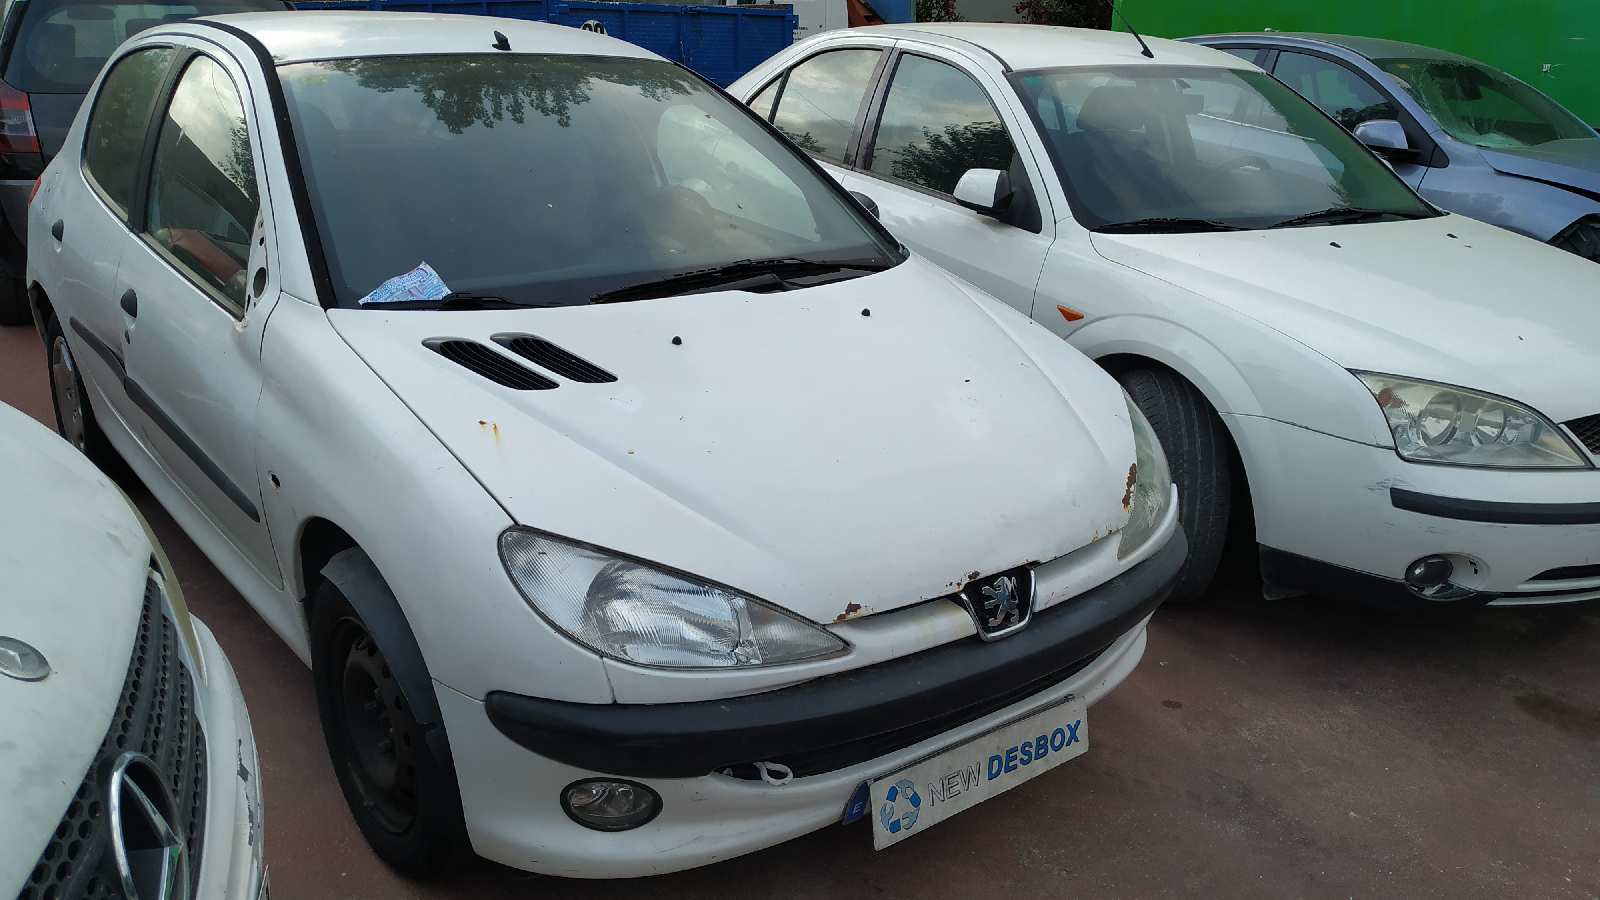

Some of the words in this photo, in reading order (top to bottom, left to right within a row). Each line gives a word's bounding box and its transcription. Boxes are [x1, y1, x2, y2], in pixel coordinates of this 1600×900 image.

[928, 762, 982, 806] NEW
[987, 719, 1081, 780] DESBOX
[853, 801, 863, 816] E
